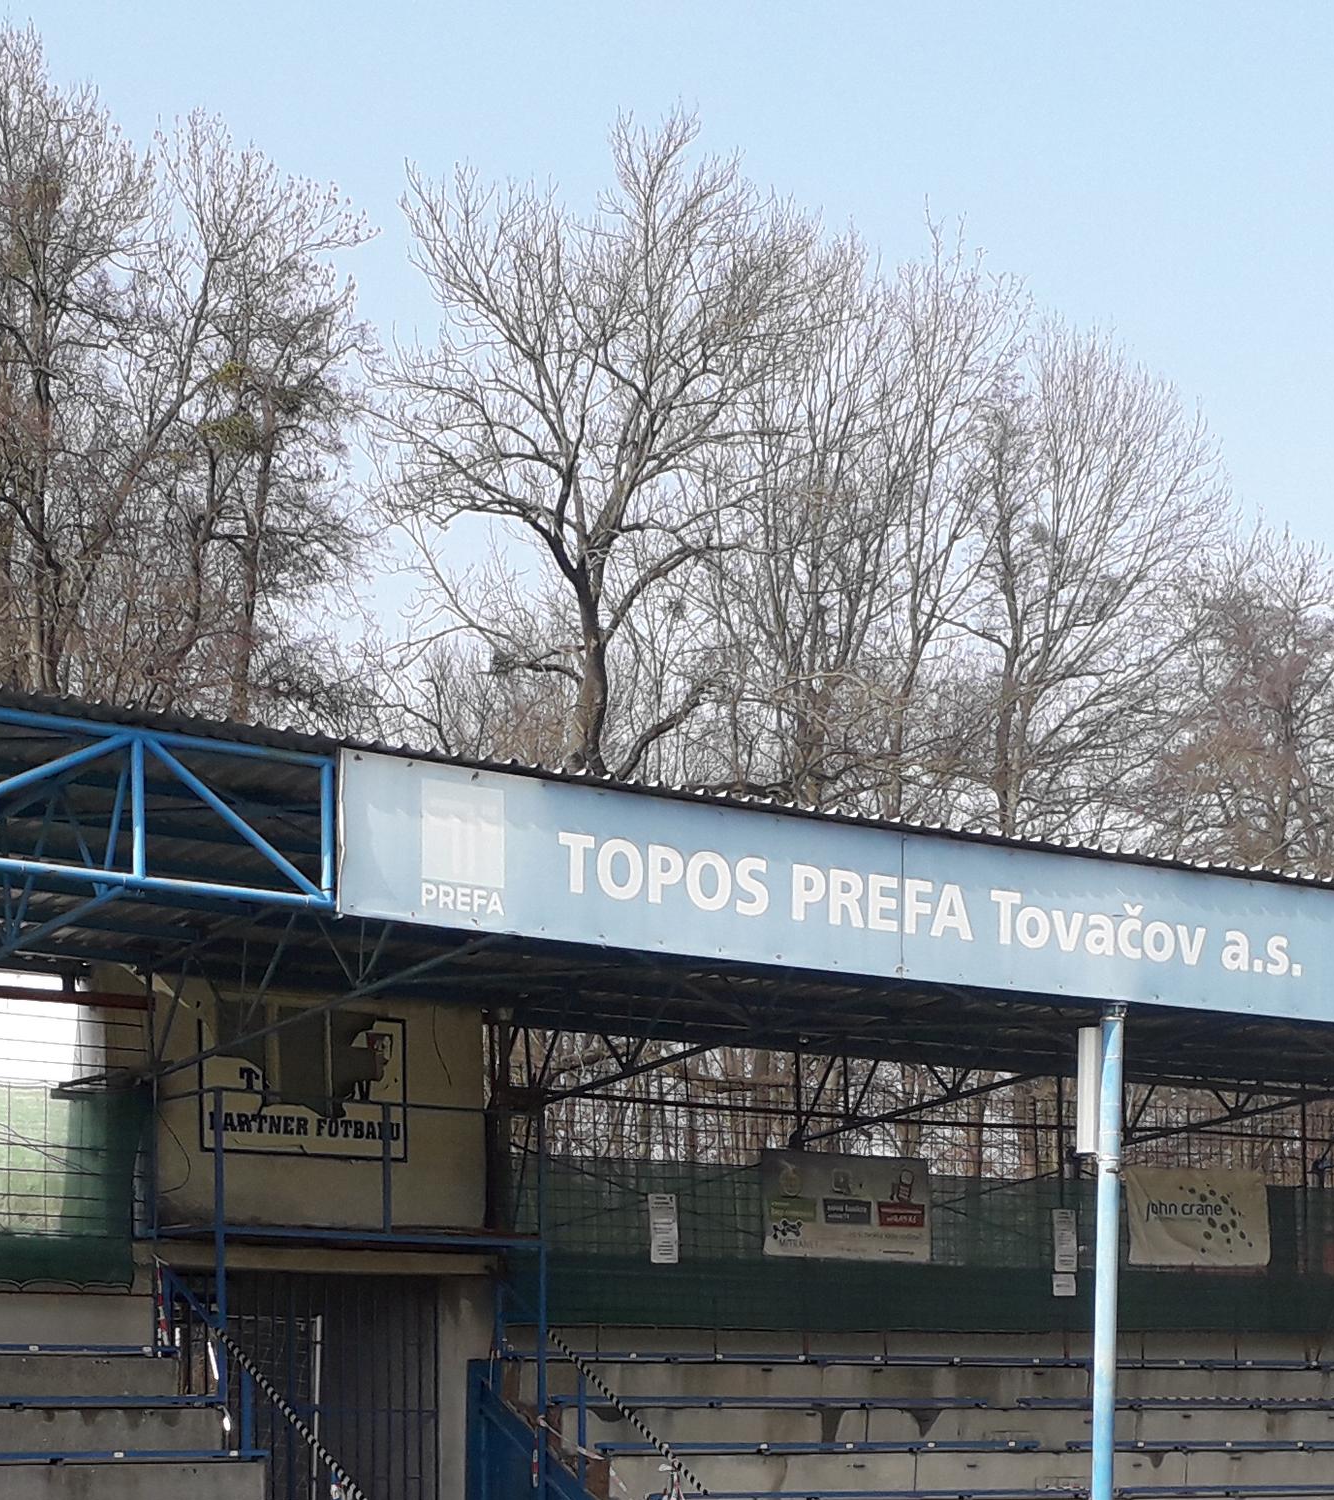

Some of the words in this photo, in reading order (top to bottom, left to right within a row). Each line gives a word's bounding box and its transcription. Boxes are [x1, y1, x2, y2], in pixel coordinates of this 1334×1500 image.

[420, 881, 505, 917] PREFA
[557, 831, 770, 918] TOPOS
[791, 862, 974, 942] PREFA
[989, 888, 1207, 967] Tovačov
[1220, 928, 1304, 977] a.s.
[1181, 1202, 1223, 1217] crane
